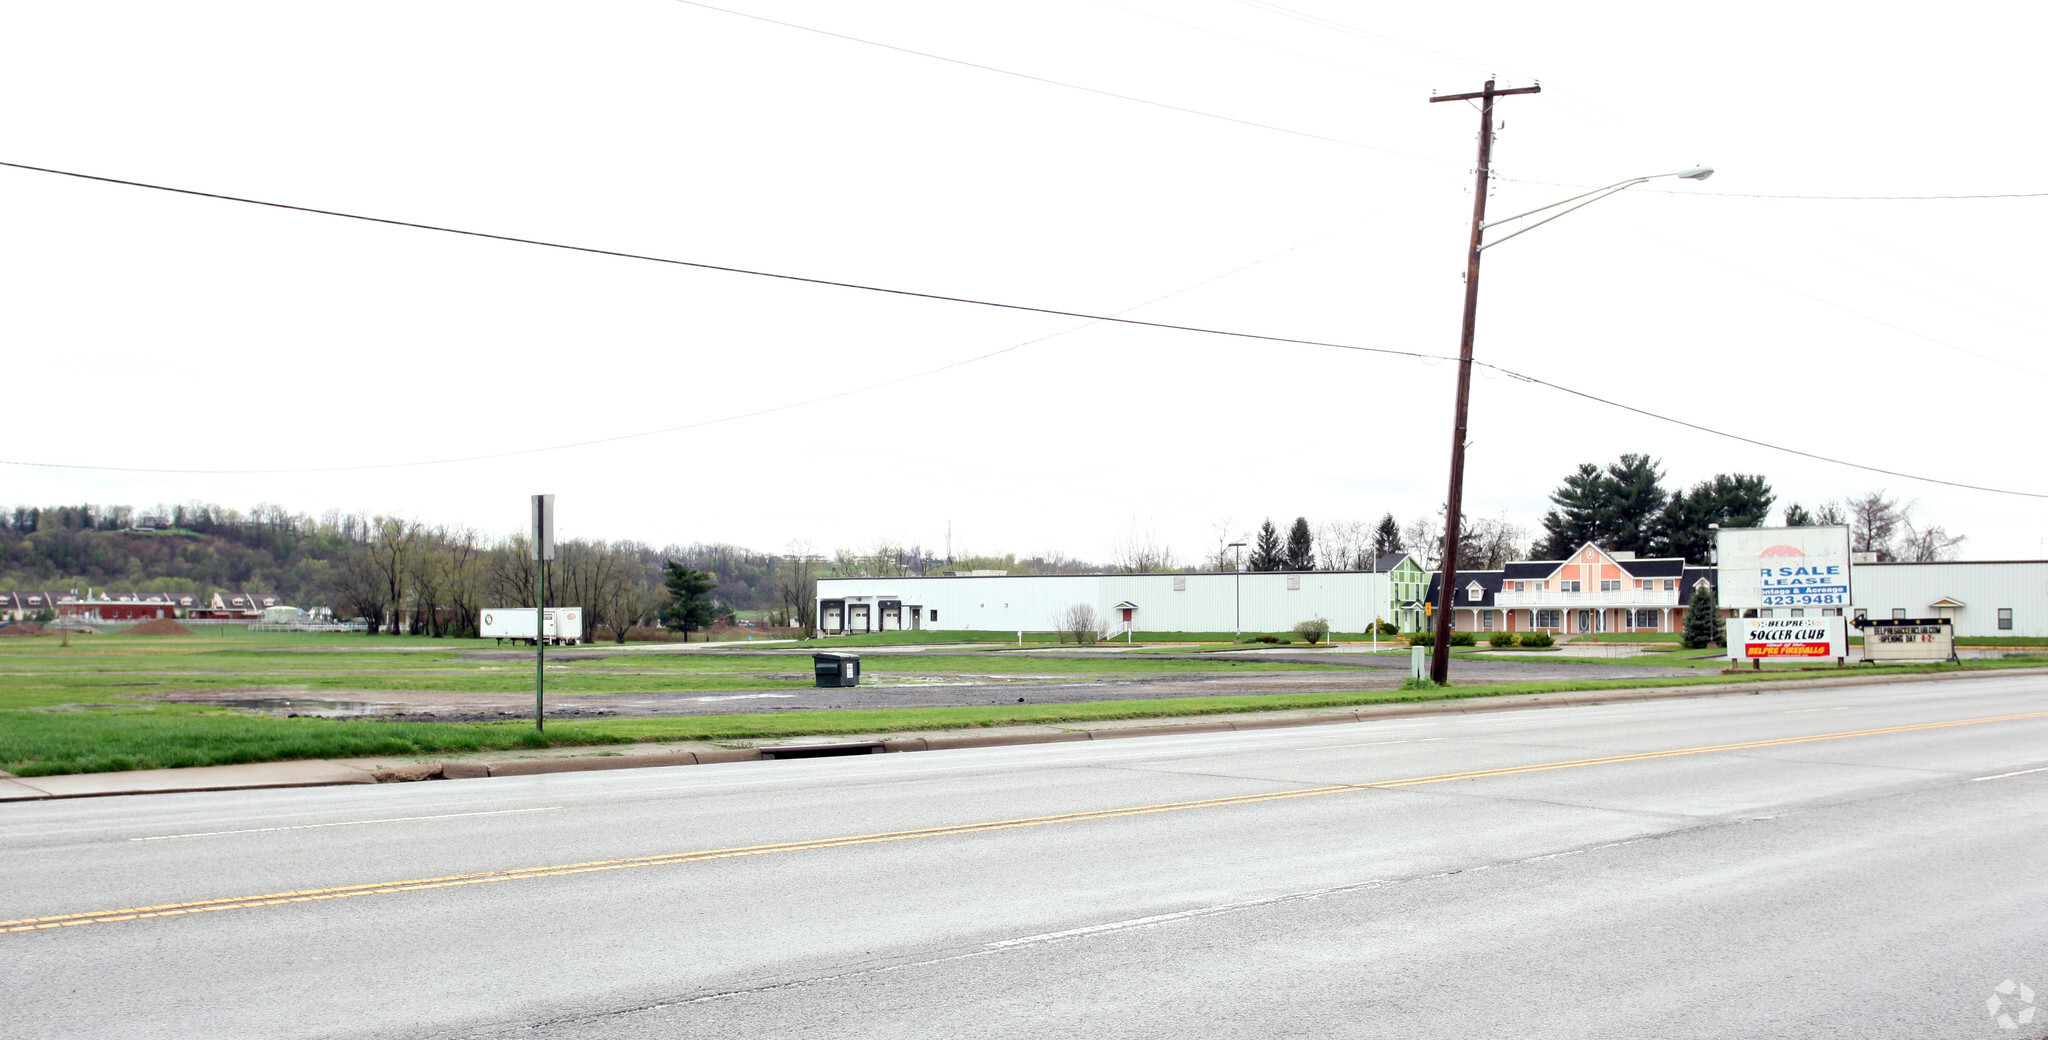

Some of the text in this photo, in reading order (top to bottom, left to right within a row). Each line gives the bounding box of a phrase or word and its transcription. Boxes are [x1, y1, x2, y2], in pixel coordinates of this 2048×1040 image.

[1779, 566, 1840, 576] SALE
[1764, 577, 1832, 586] LEASE
[1763, 595, 1843, 605] 423-9481
[1749, 629, 1825, 640] SOCCER CLUB
[1905, 634, 1916, 643] DAY
[1748, 646, 1825, 655] BELPRE FIREBALLS
